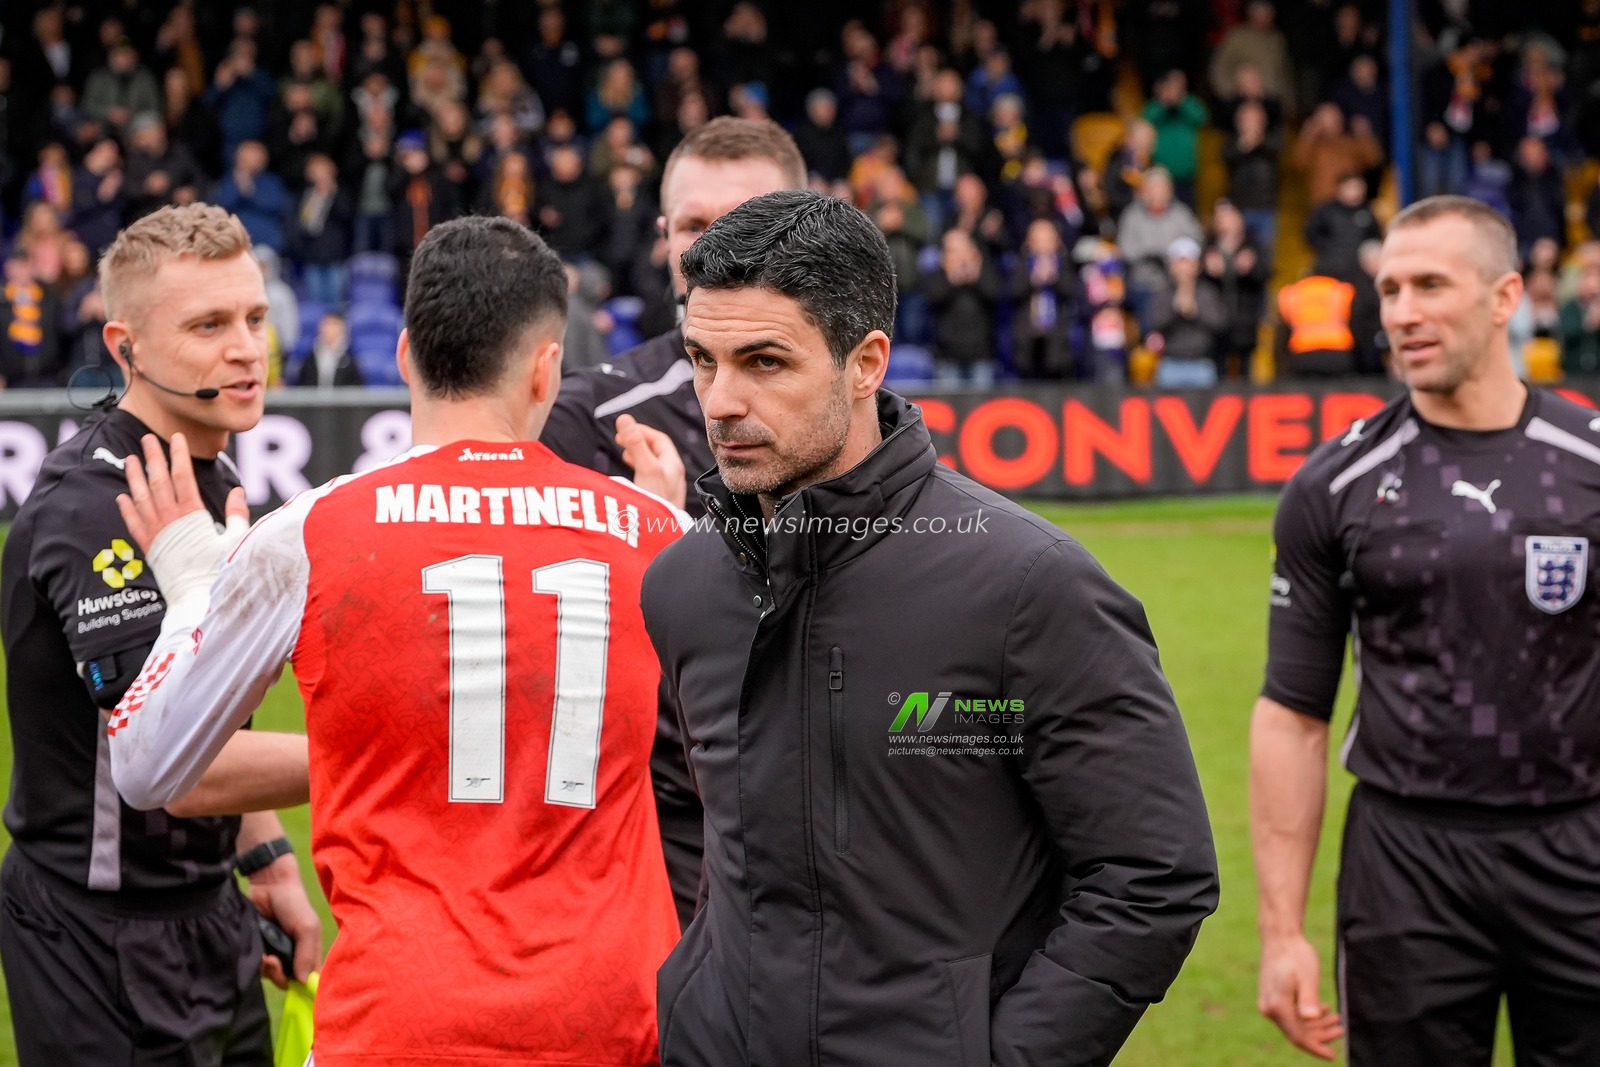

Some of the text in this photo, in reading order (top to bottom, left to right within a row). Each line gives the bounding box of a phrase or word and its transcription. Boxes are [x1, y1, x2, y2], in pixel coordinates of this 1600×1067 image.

[457, 447, 525, 462] Arsenal
[375, 484, 640, 549] MARTINELLI
[77, 602, 163, 634] Building Supplies
[421, 553, 610, 809] 11
